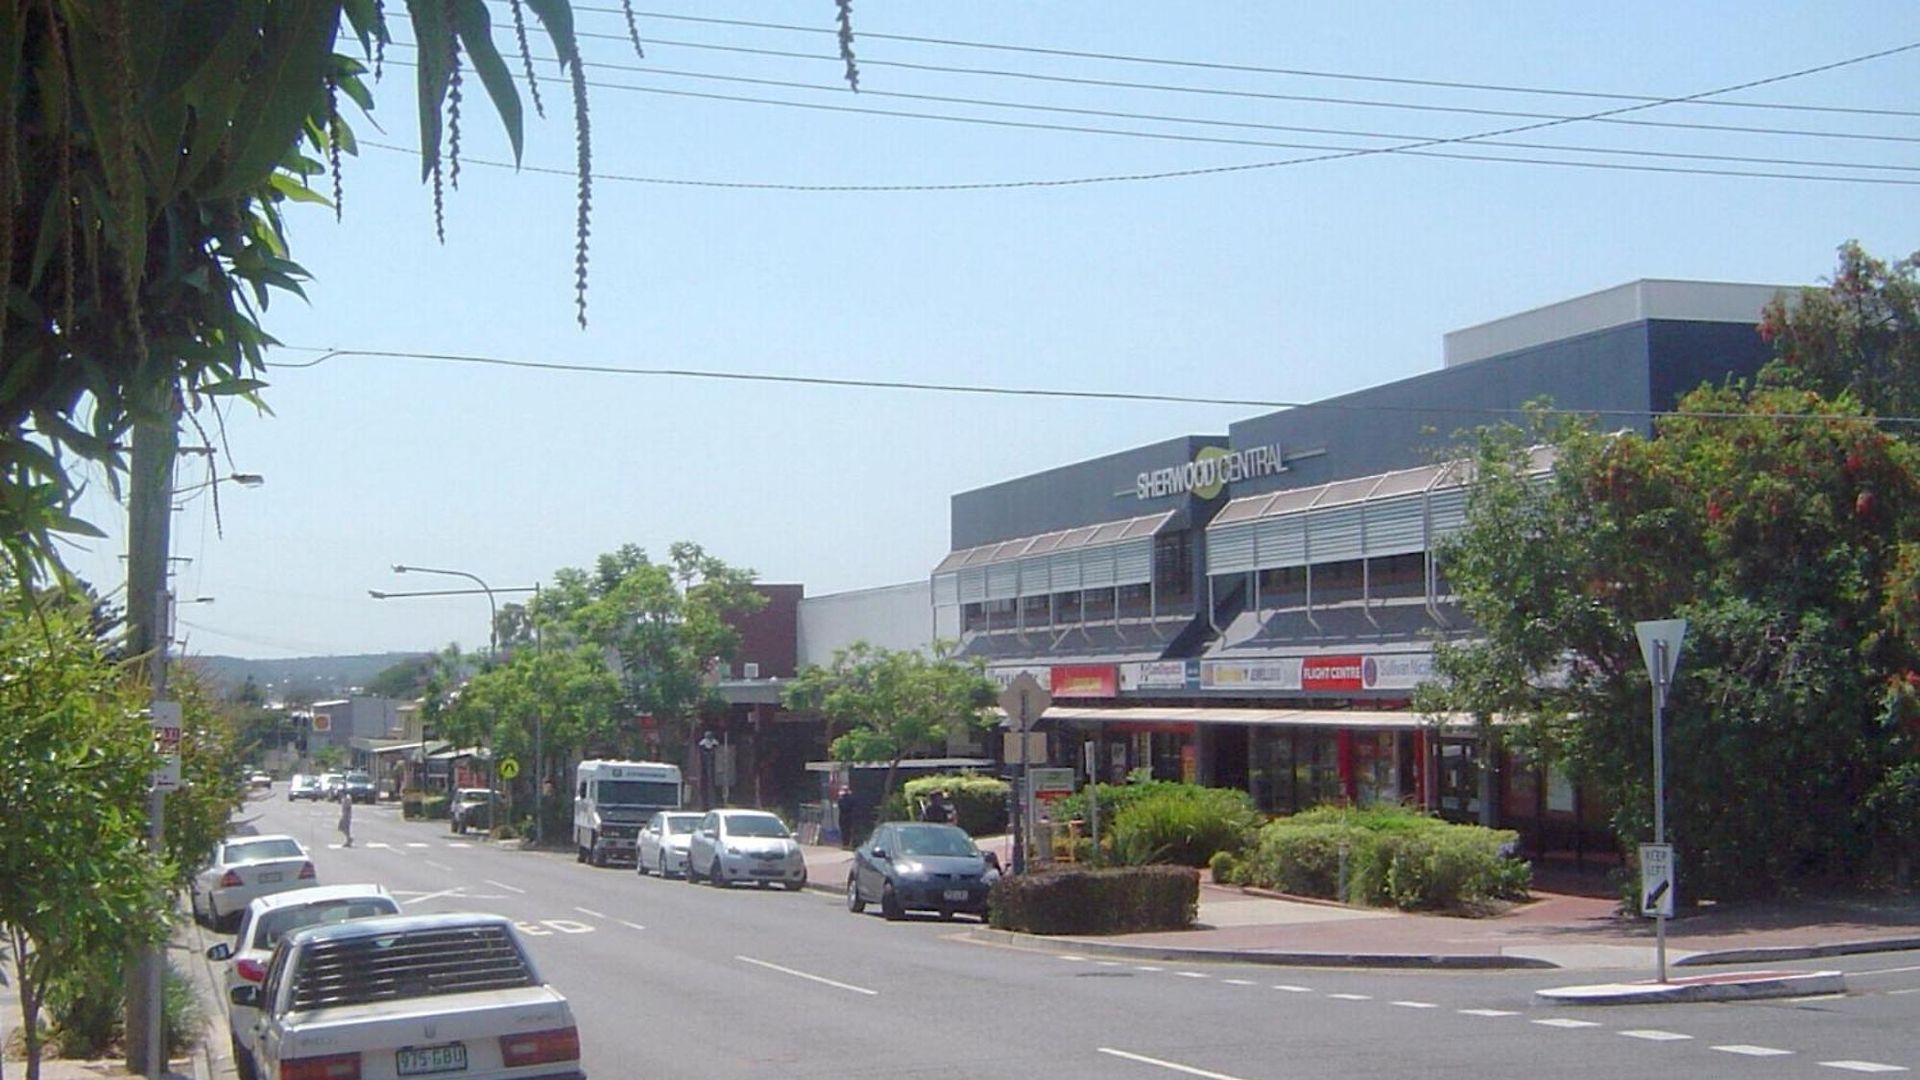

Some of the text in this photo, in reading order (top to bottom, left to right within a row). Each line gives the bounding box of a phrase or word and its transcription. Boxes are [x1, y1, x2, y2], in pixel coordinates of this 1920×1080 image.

[1136, 442, 1288, 500] SHERWOOD CENTRAL
[1303, 665, 1361, 680] FLIGHT CENTRE
[1645, 849, 1667, 862] KEEP
[1646, 864, 1667, 877] LEFT
